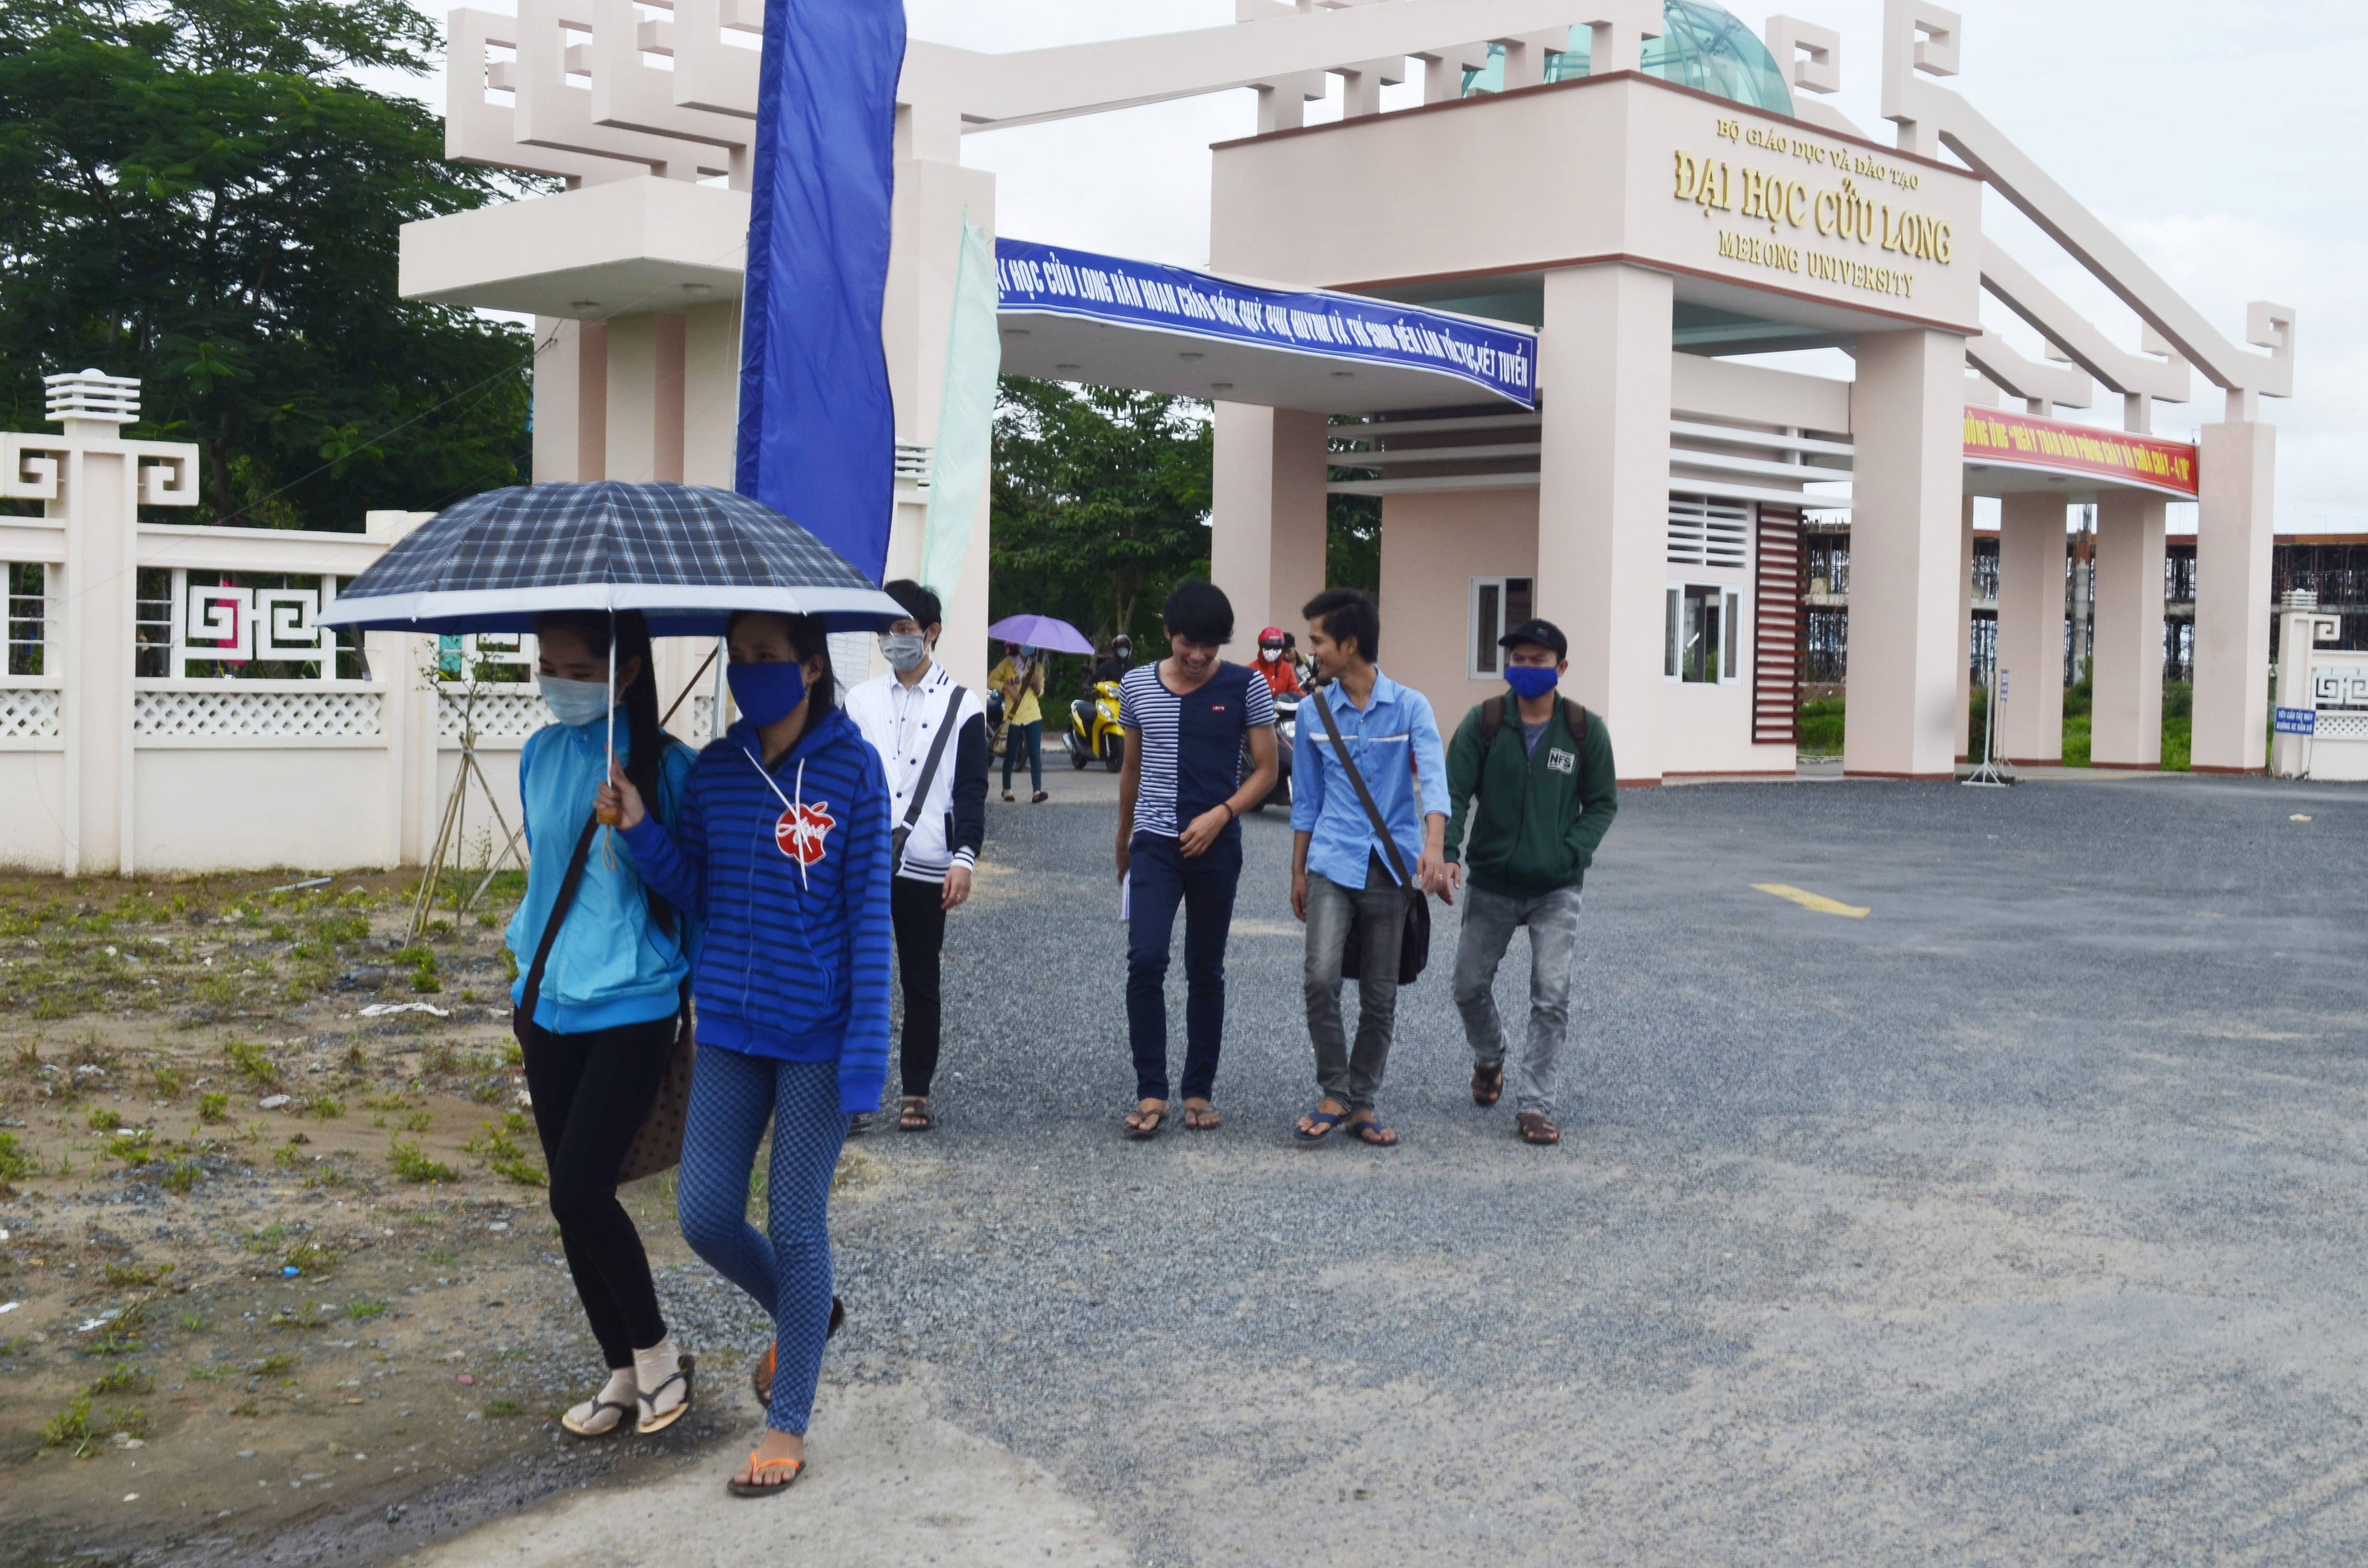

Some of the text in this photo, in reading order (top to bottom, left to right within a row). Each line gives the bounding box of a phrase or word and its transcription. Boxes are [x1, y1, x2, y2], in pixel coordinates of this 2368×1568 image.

[1717, 118, 1919, 190] BỘ GIÁO DỤC VÀ ĐÀO TẠO
[1674, 149, 1952, 265] ĐẠI HỌC CỬU LONG
[1719, 230, 1914, 297] MEKONG UNIVERSITY
[1009, 259, 1044, 300] HỌC
[1042, 251, 1076, 297] CỬU
[1073, 266, 1114, 303] LONG
[1110, 269, 1143, 308] HÂN
[1139, 278, 1180, 315] HOAN
[1266, 304, 1295, 343] PHỤ
[1291, 308, 1334, 343] HUYNH
[1329, 309, 1352, 345] VÀ
[1346, 314, 1372, 348] THÍ
[1366, 321, 1399, 351] SINH
[1393, 318, 1422, 354] ĐẾN
[1416, 323, 1445, 359] LÀM
[1477, 341, 1495, 377] XÉT
[1498, 343, 1527, 387] TUYỂN
[1550, 753, 1570, 768] NFS
